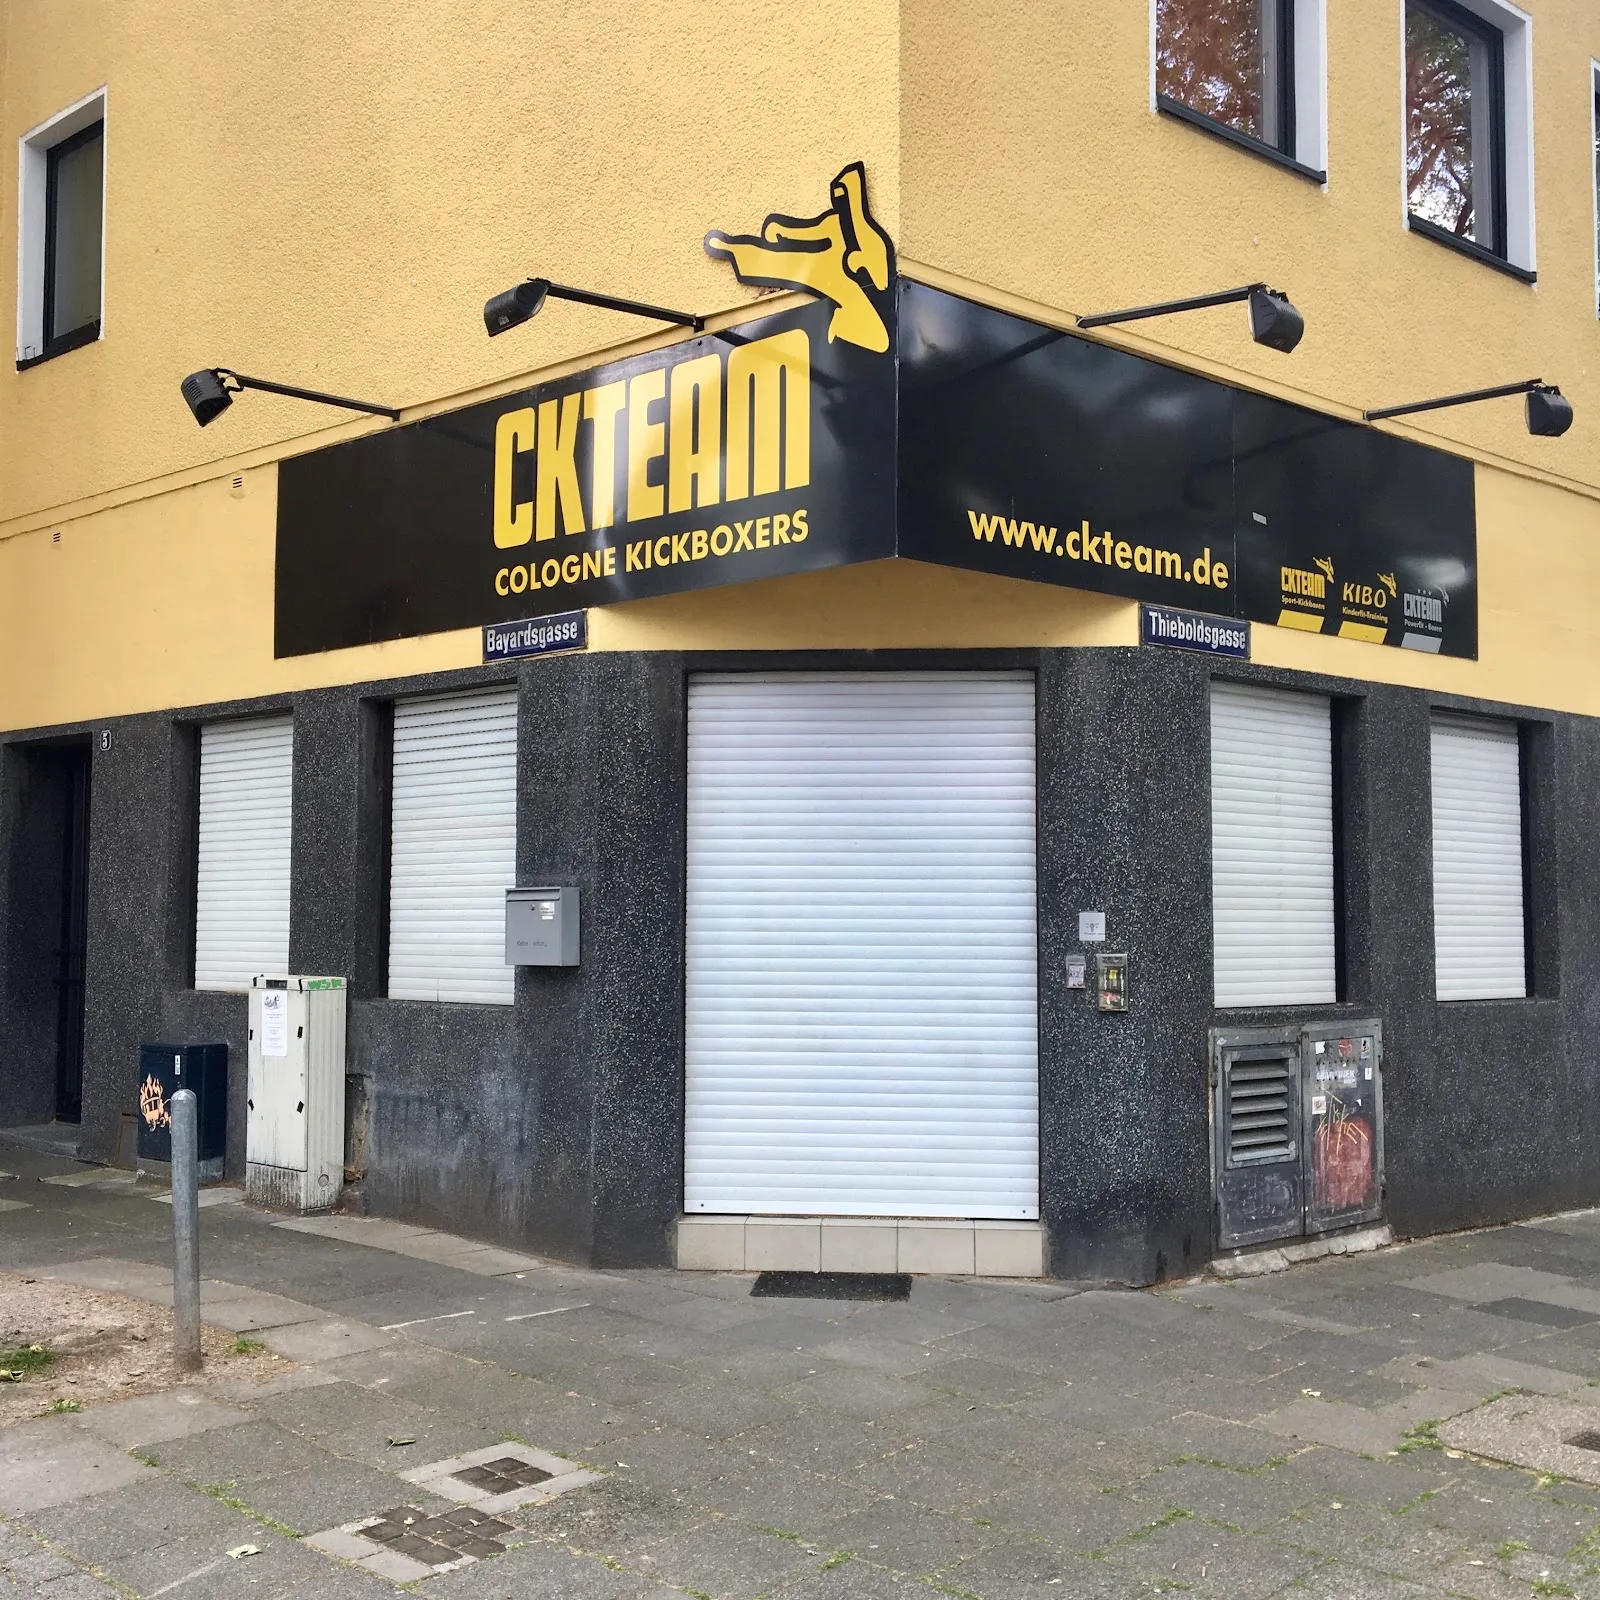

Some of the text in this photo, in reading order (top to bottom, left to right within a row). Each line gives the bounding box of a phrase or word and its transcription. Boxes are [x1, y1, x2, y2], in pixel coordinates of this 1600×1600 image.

[493, 328, 810, 550] CKTEAM
[494, 509, 809, 596] COLOGNE KICKBOXERS
[967, 509, 1229, 589] www.ckteam.de
[1281, 566, 1326, 599] CKTEAM
[1342, 582, 1387, 608] KIBO
[1403, 592, 1442, 623] CKTEAM
[1148, 611, 1246, 649] Thieboldsgasse
